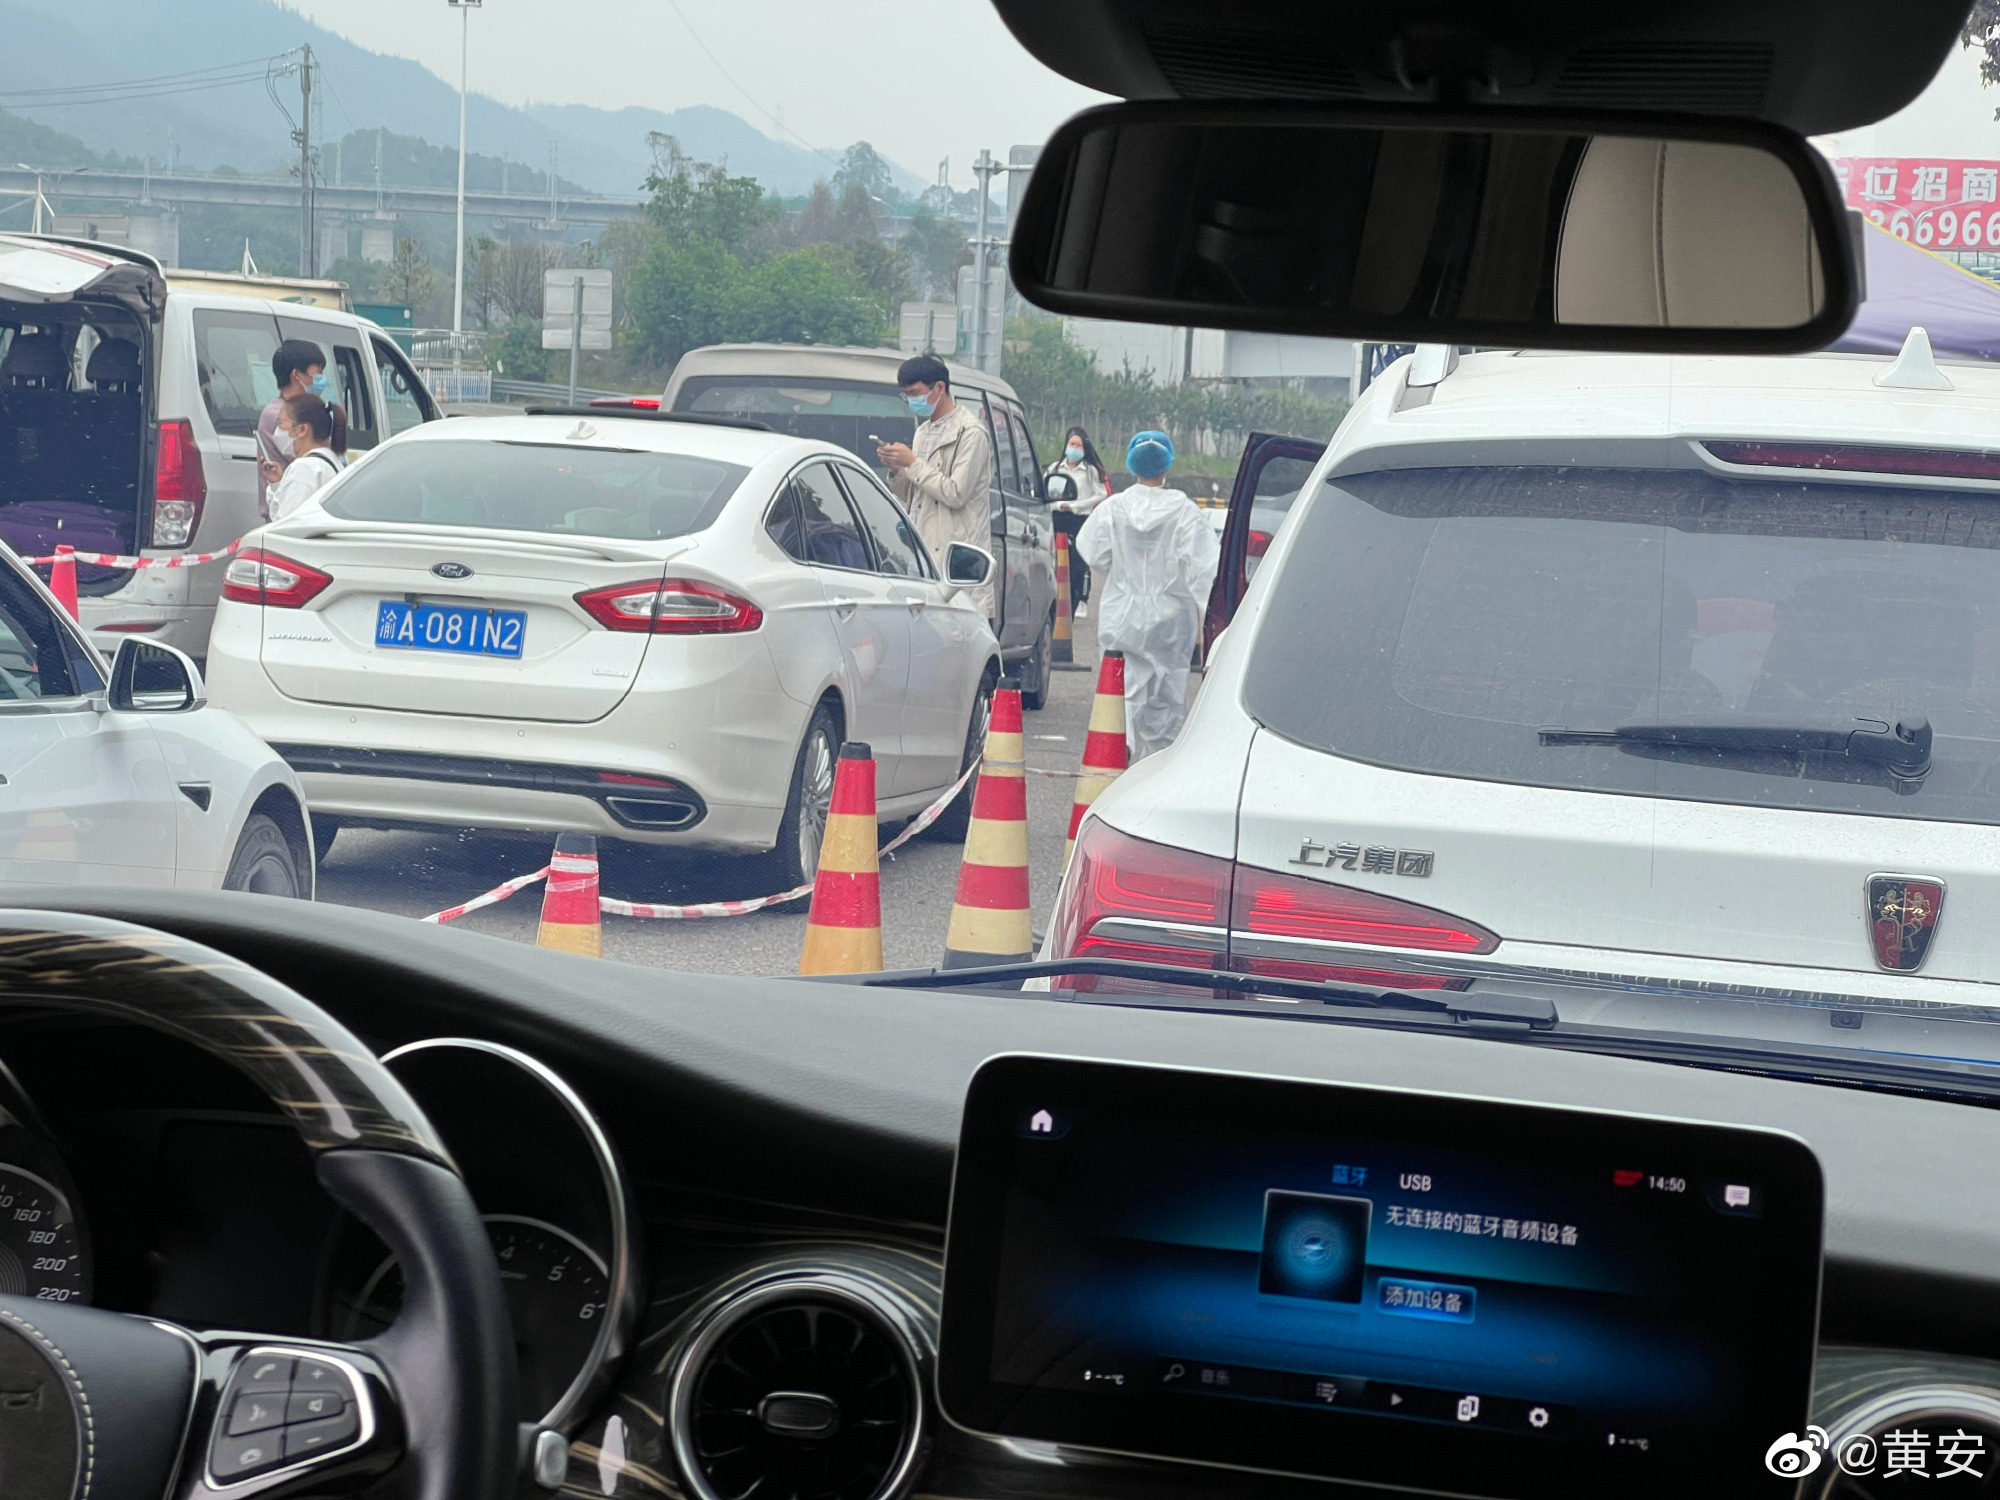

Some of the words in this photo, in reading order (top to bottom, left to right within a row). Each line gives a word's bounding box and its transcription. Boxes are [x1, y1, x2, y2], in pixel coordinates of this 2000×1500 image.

[438, 563, 464, 577] Ford
[1288, 836, 1435, 878] 上汽集团
[1332, 1164, 1369, 1186] 蓝牙
[1399, 1172, 1432, 1192] USB
[1648, 1175, 1686, 1193] 14:50
[13, 1208, 41, 1222] 160
[1386, 1205, 1579, 1247] 无连接的蓝牙音频设备
[27, 1230, 57, 1245] 180
[499, 1245, 517, 1261] 4
[32, 1257, 67, 1272] 200
[547, 1265, 566, 1281] 5
[36, 1286, 70, 1301] 220
[1385, 1285, 1463, 1314] 添加设备
[579, 1303, 597, 1319] 6
